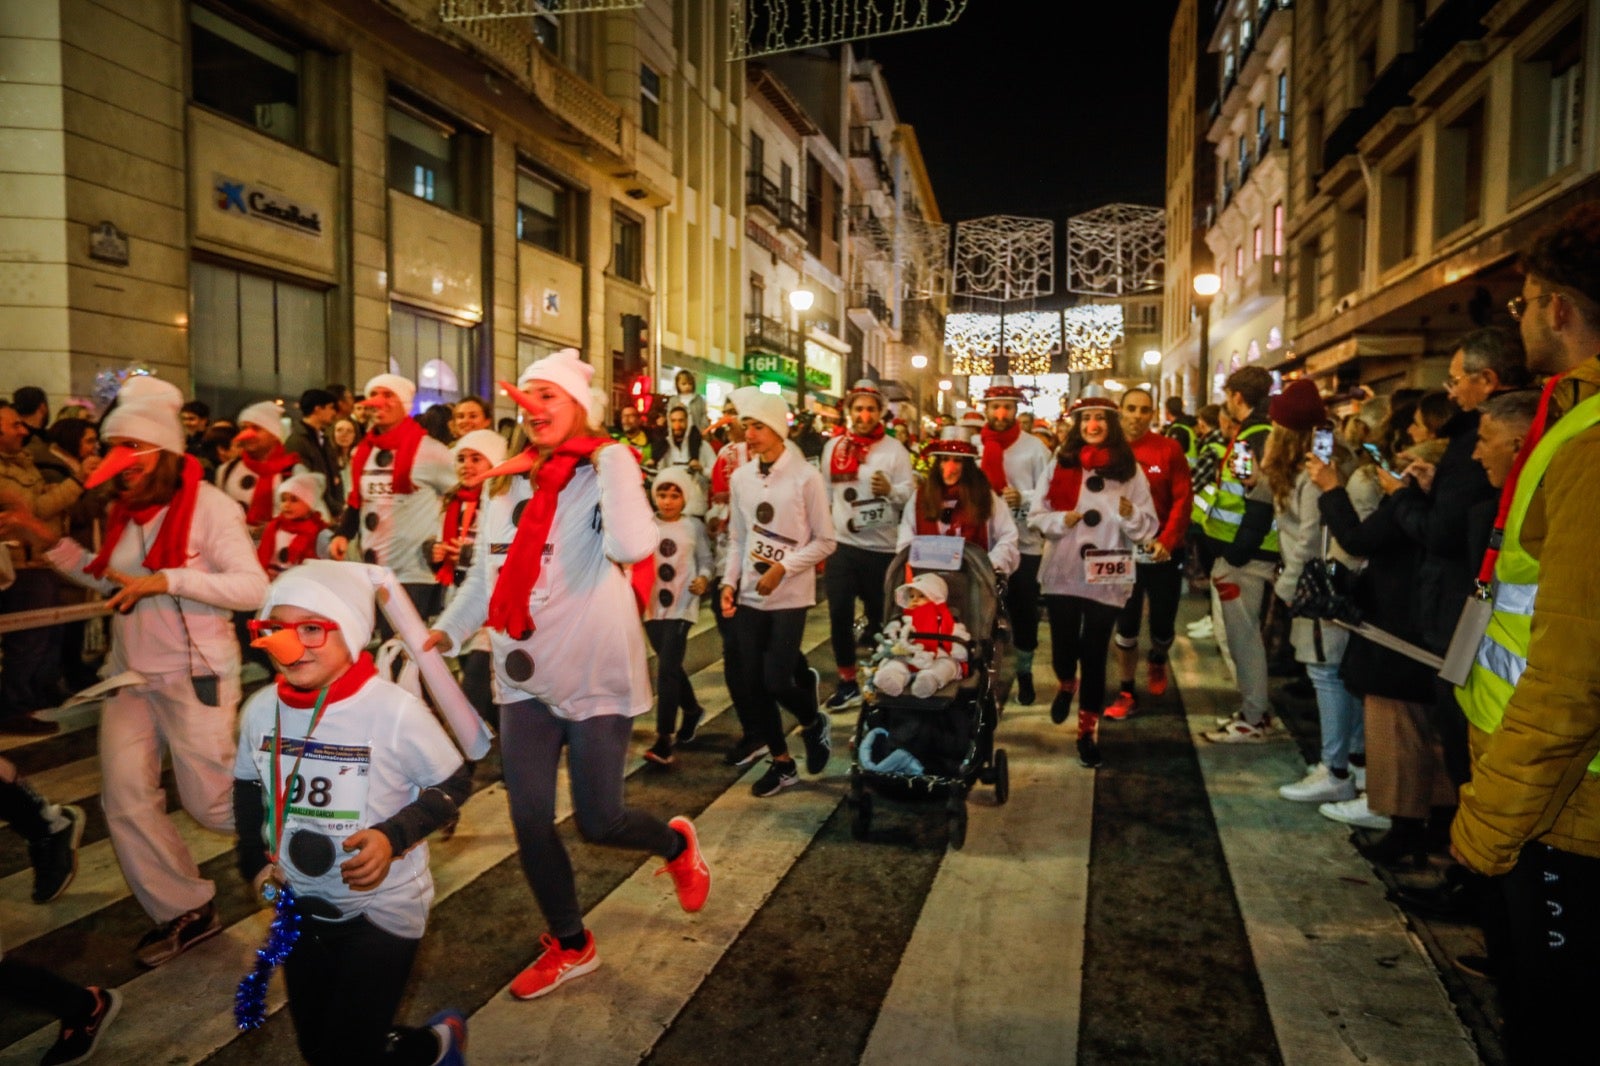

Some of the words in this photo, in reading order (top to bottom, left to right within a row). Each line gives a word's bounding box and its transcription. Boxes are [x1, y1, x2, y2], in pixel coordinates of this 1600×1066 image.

[747, 357, 777, 371] 16H
[860, 508, 884, 520] 797
[754, 541, 784, 561] 330
[1095, 562, 1126, 574] 798
[285, 773, 332, 807] 98
